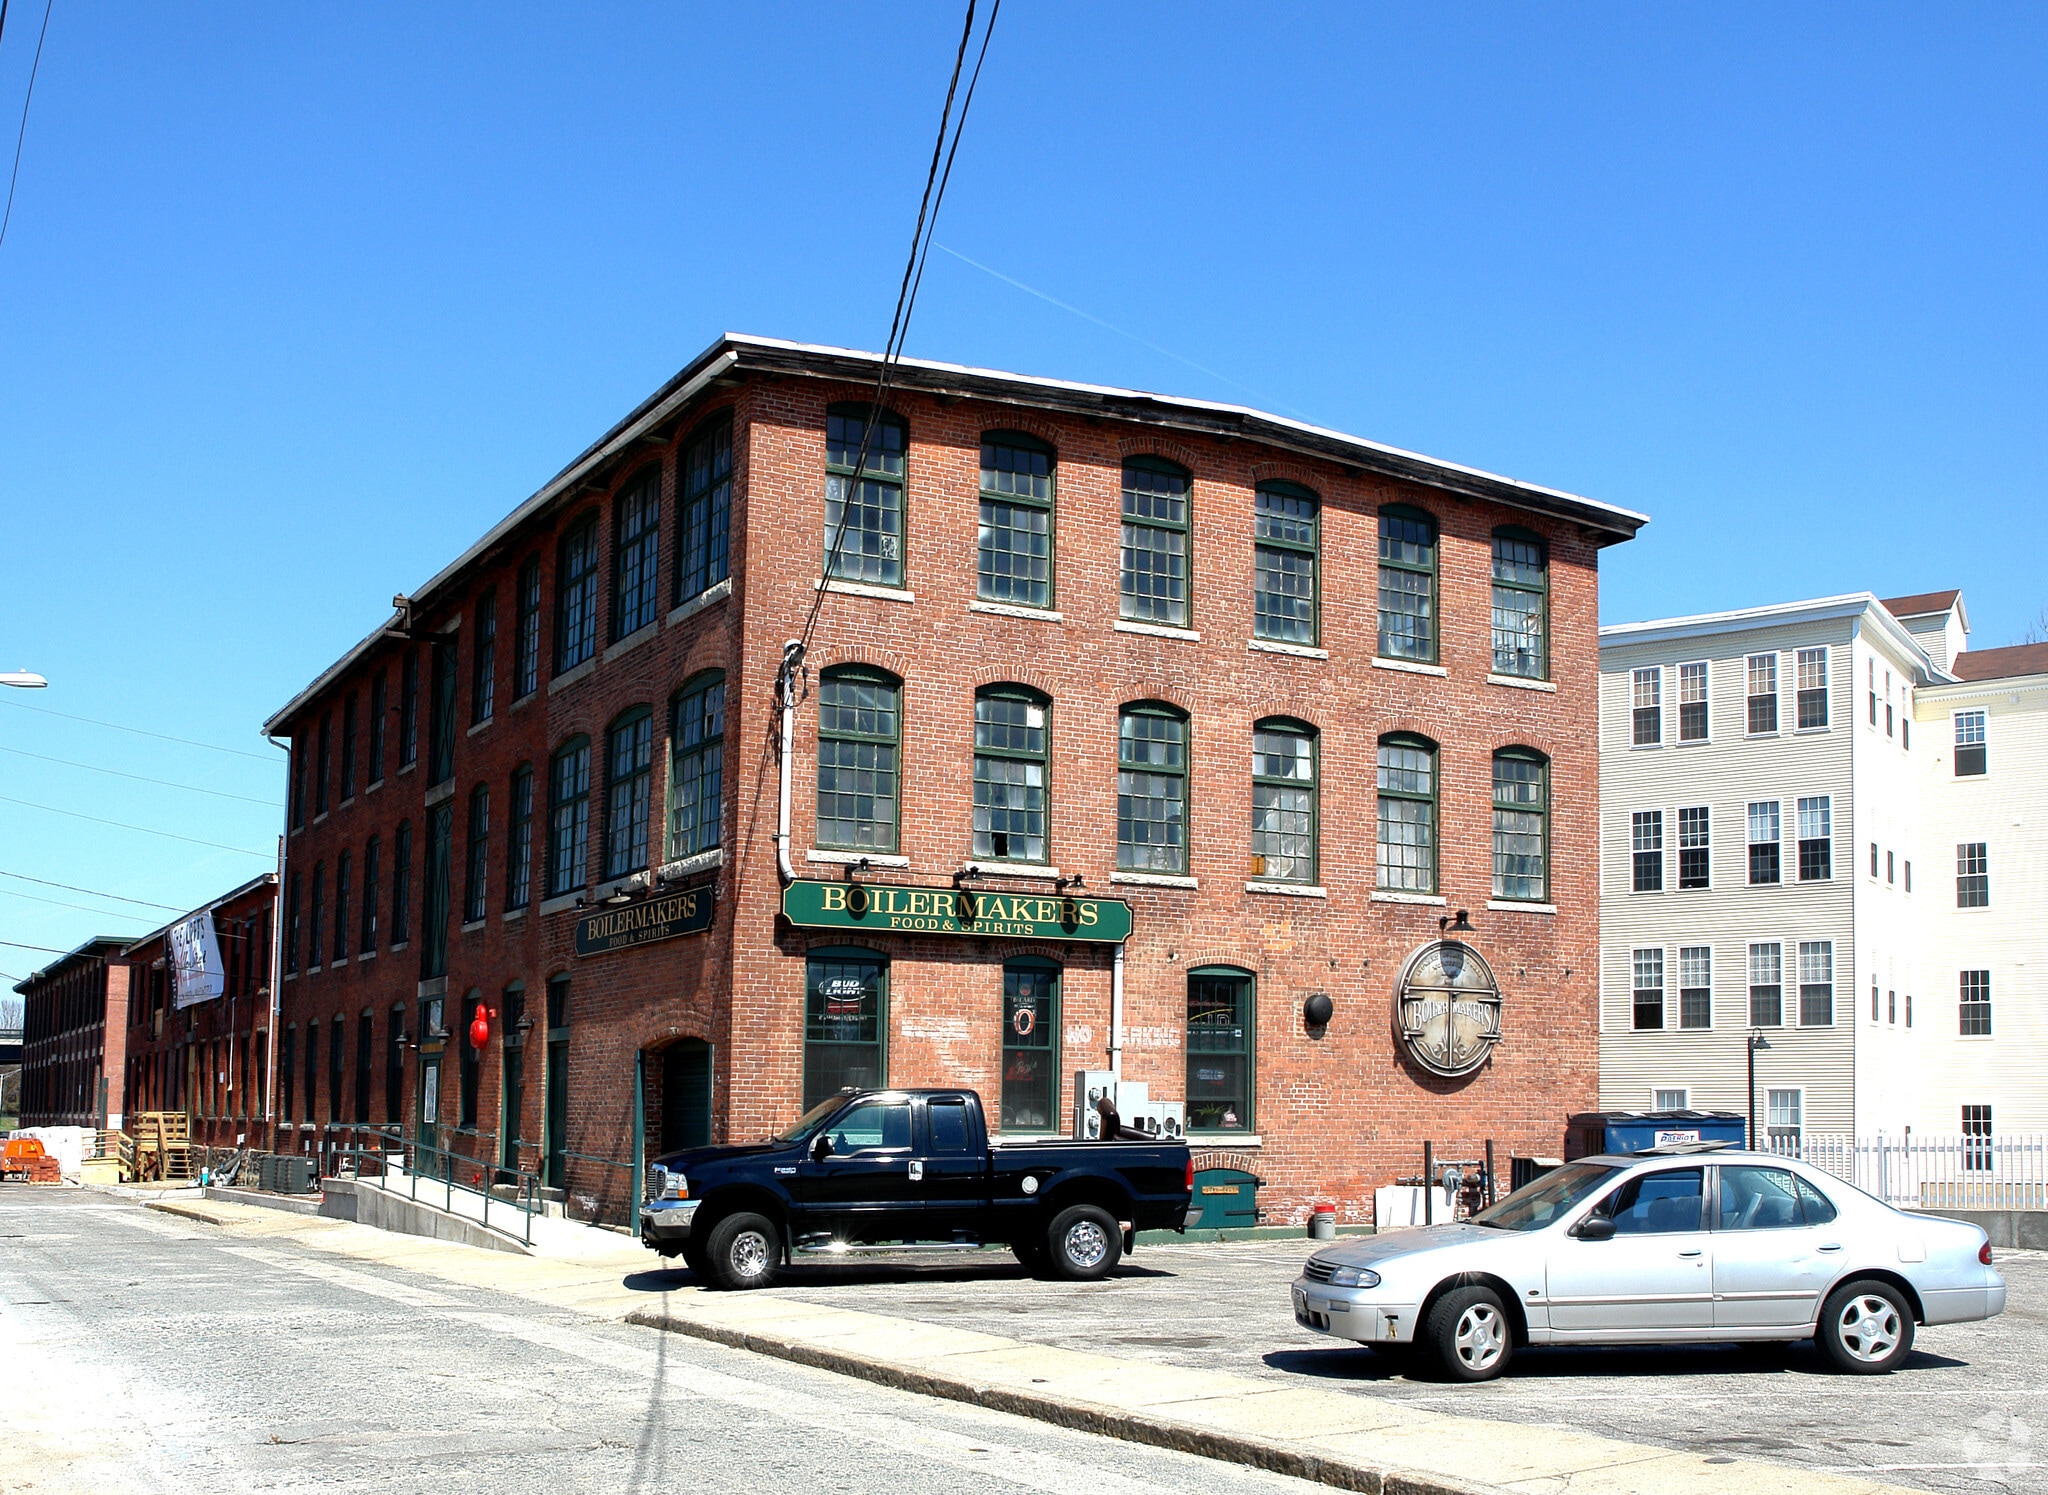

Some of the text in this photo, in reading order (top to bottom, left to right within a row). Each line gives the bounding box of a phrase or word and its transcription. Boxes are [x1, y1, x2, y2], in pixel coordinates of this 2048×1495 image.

[822, 886, 1099, 926] BOILERMAKERS
[588, 894, 697, 940] BOILERMAKERS
[890, 916, 1034, 935] FOOD & SPIRITS
[609, 934, 627, 947] FOOD
[638, 925, 671, 941] SPIRITS
[831, 980, 859, 988] BUD
[1066, 1025, 1092, 1043] NO
